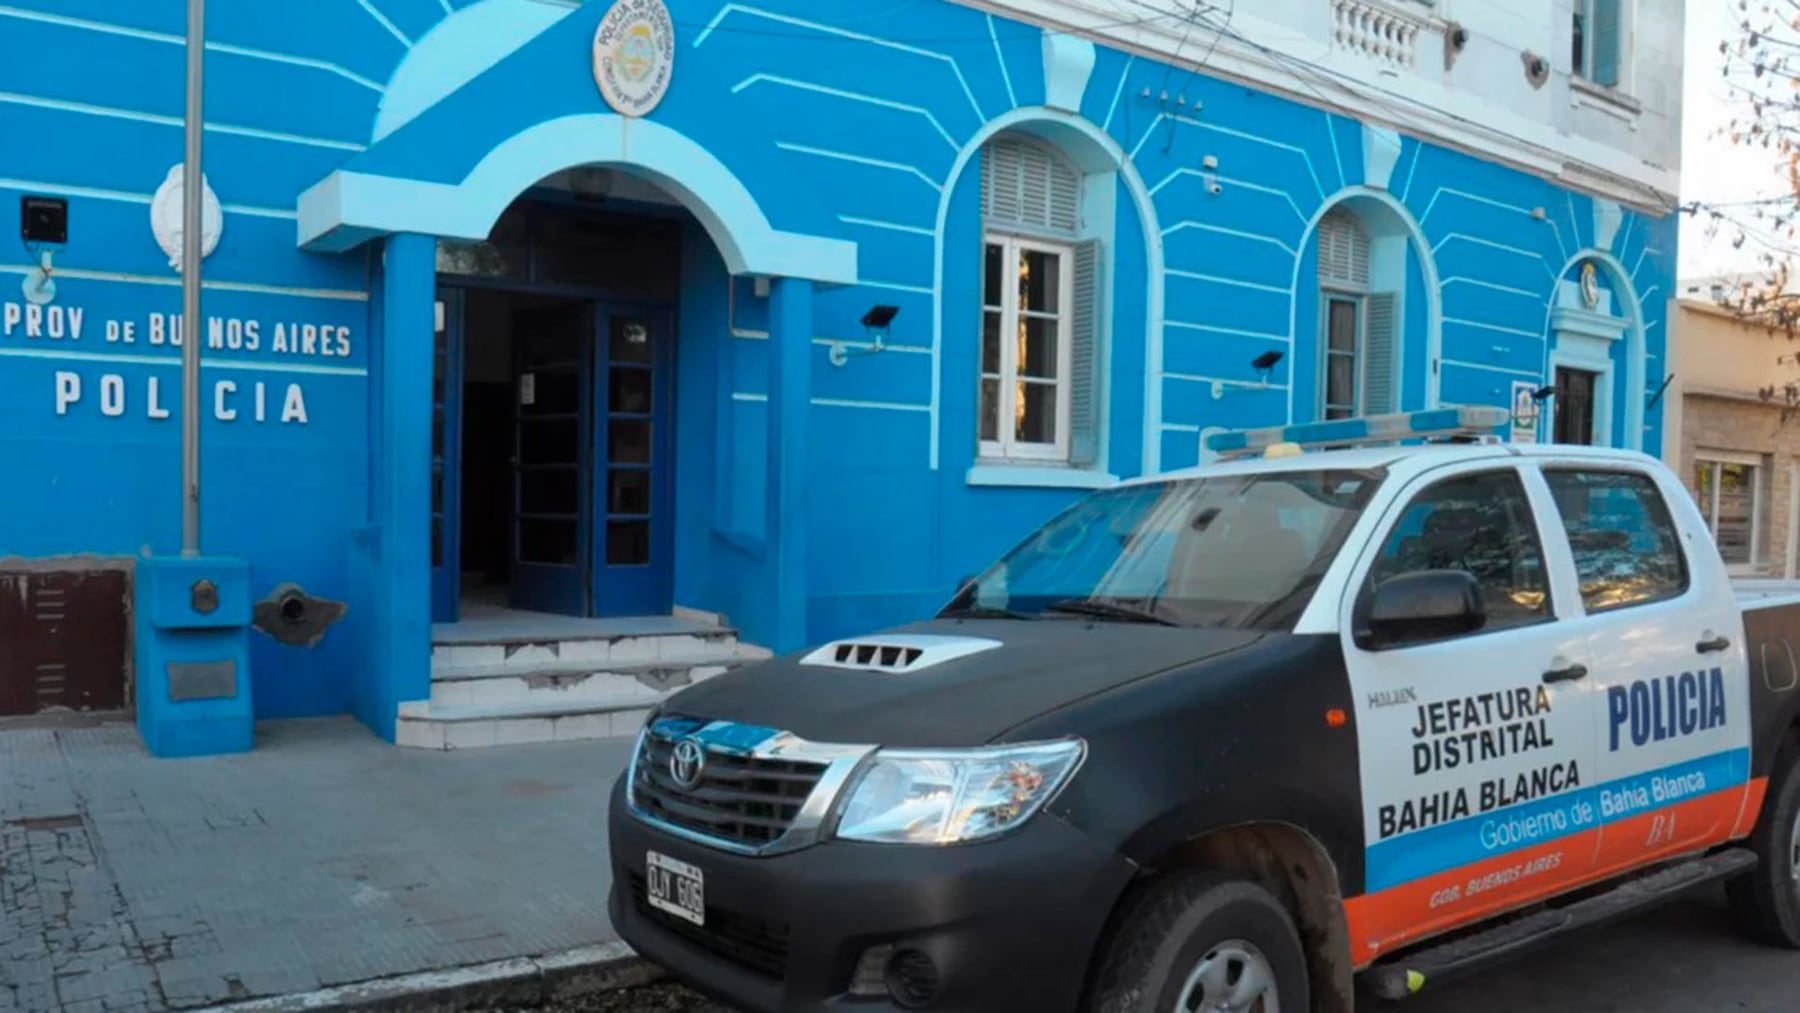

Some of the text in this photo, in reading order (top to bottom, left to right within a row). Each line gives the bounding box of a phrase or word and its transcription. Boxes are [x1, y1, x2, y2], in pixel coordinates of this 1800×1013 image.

[4, 302, 351, 357] PROV DE BUNOS AIRES
[55, 371, 309, 424] POLCIA
[1412, 684, 1552, 738] JEFATURA
[1607, 667, 1727, 752] POLICIA
[1412, 718, 1554, 775] DISTRITAL
[1379, 759, 1580, 840] BAHIA BLANCA
[1480, 808, 1567, 850] Gobierno
[1571, 800, 1593, 825] de
[1651, 771, 1706, 802] Blanca
[1465, 865, 1522, 896] BUENOS
[1521, 852, 1562, 879] AIRES
